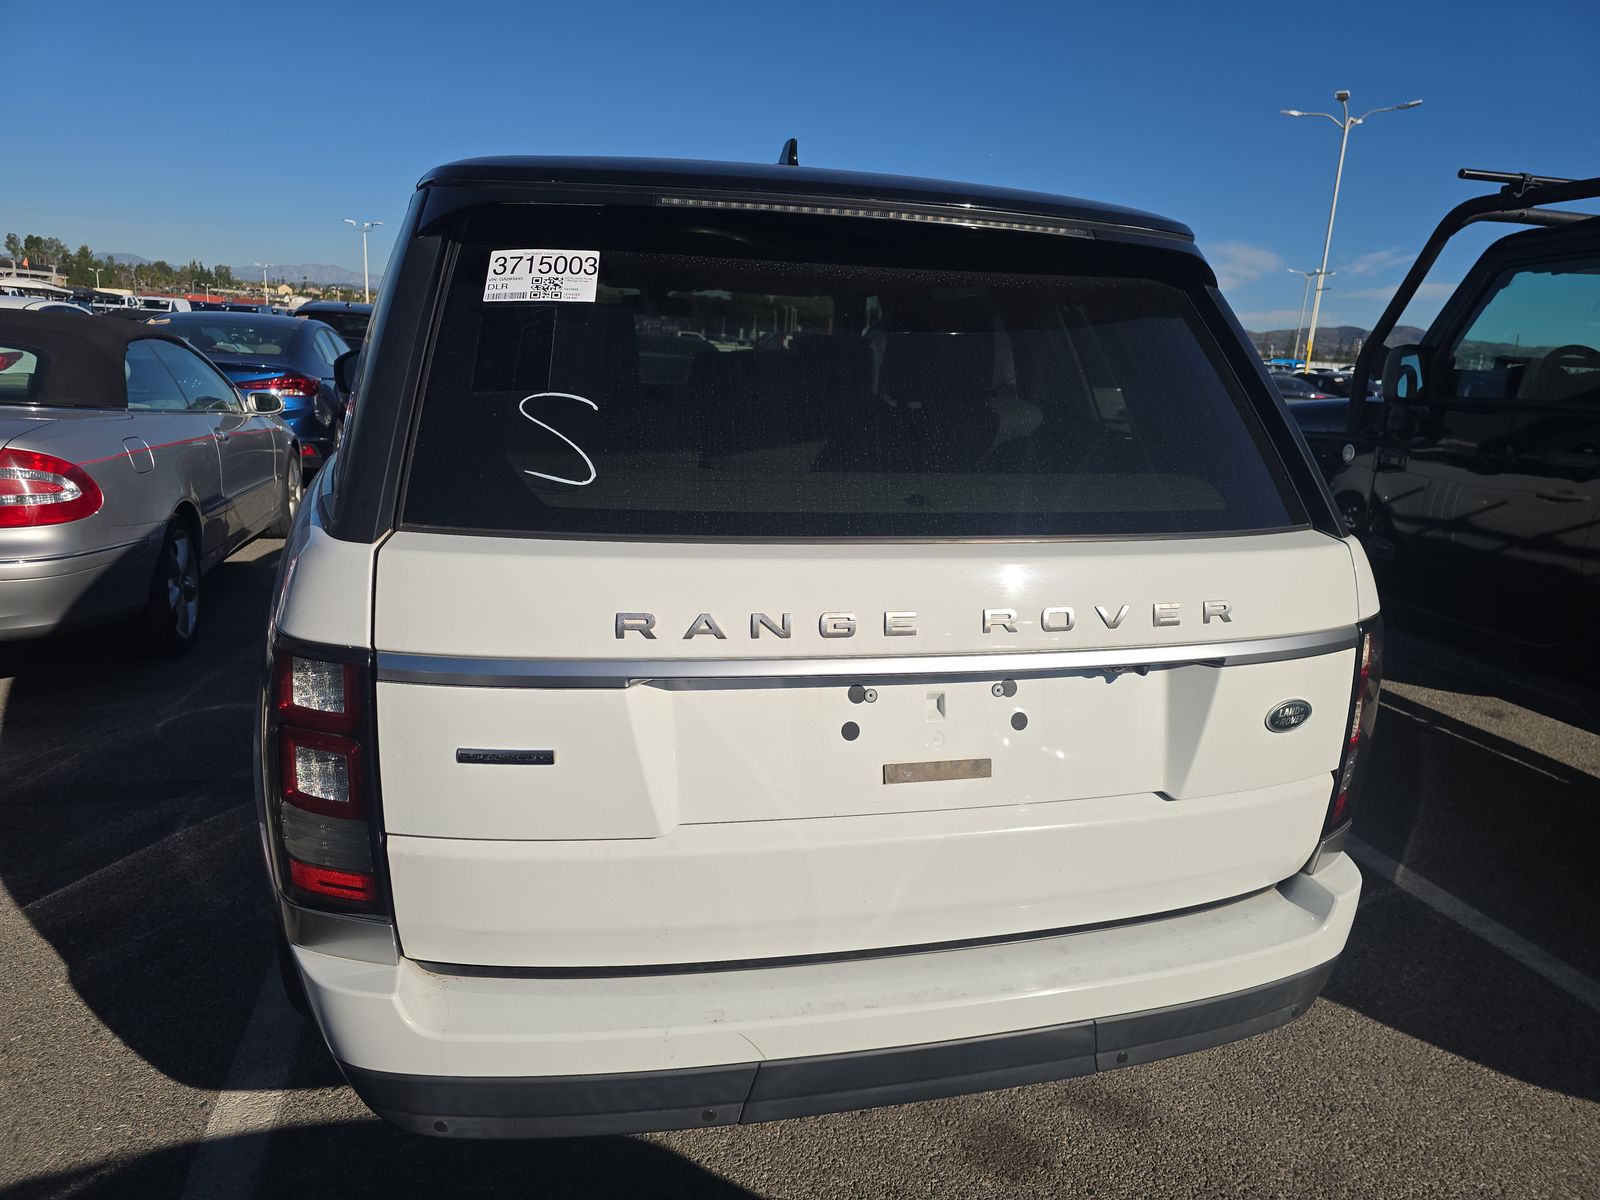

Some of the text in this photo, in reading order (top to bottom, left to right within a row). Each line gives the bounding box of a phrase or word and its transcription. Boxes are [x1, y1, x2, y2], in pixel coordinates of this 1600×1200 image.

[493, 255, 598, 276] 3715003
[487, 283, 509, 291] DLR
[519, 392, 599, 486] S
[615, 600, 1233, 640] RANGE ROVER
[1279, 706, 1300, 718] LAND
[1279, 714, 1304, 726] ROVER
